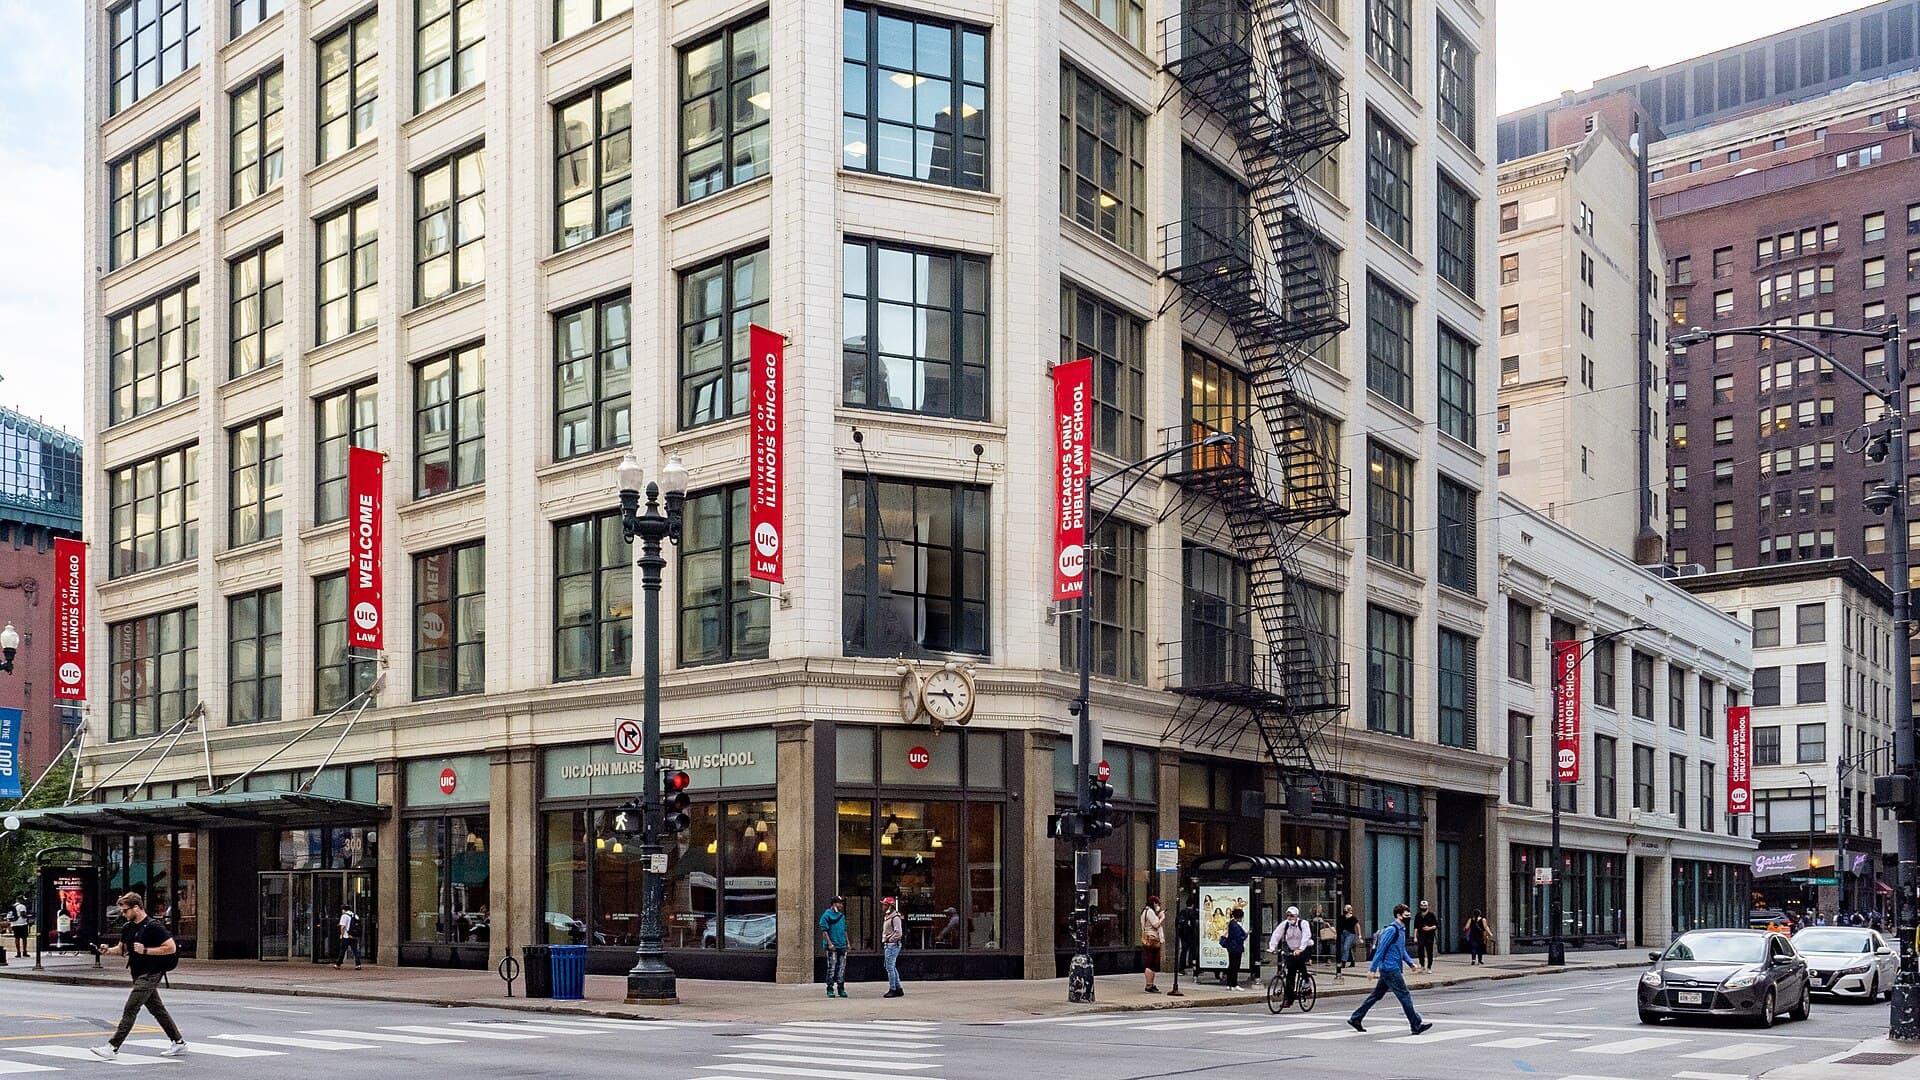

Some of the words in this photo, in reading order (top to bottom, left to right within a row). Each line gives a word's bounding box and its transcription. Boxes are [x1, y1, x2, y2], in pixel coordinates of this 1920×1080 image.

[766, 353, 777, 431] CHICAGO
[757, 404, 764, 419] OF
[1073, 382, 1084, 442] SCHOOL
[1062, 414, 1072, 451] ONLY
[1073, 450, 1084, 475] LAW
[766, 435, 777, 508] ILLINOIS
[1062, 454, 1072, 531] CHICAGO'S
[1073, 478, 1084, 529] PUBLIC
[360, 494, 373, 589] WELCOME
[757, 531, 777, 547] UIC
[757, 560, 777, 574] LAW
[1062, 555, 1084, 568] UIC
[70, 555, 79, 605] CHICAGO
[1061, 581, 1084, 593] LAW
[62, 588, 68, 599] OF
[357, 610, 376, 622] UIC
[70, 607, 79, 653] ILLINOIS
[356, 632, 377, 643] LAW
[61, 669, 80, 679] UIC
[61, 686, 79, 695] LAW
[1566, 699, 1574, 740] ILLINOIS
[561, 765, 580, 779] UIC
[580, 763, 610, 778] JOHN
[674, 755, 702, 770] LAW
[703, 752, 755, 769] SCHOOL
[909, 753, 929, 763] UIC
[1099, 766, 1110, 776] UIC
[1558, 770, 1574, 778] LAW
[441, 776, 455, 787] UIC
[344, 838, 361, 851] 300
